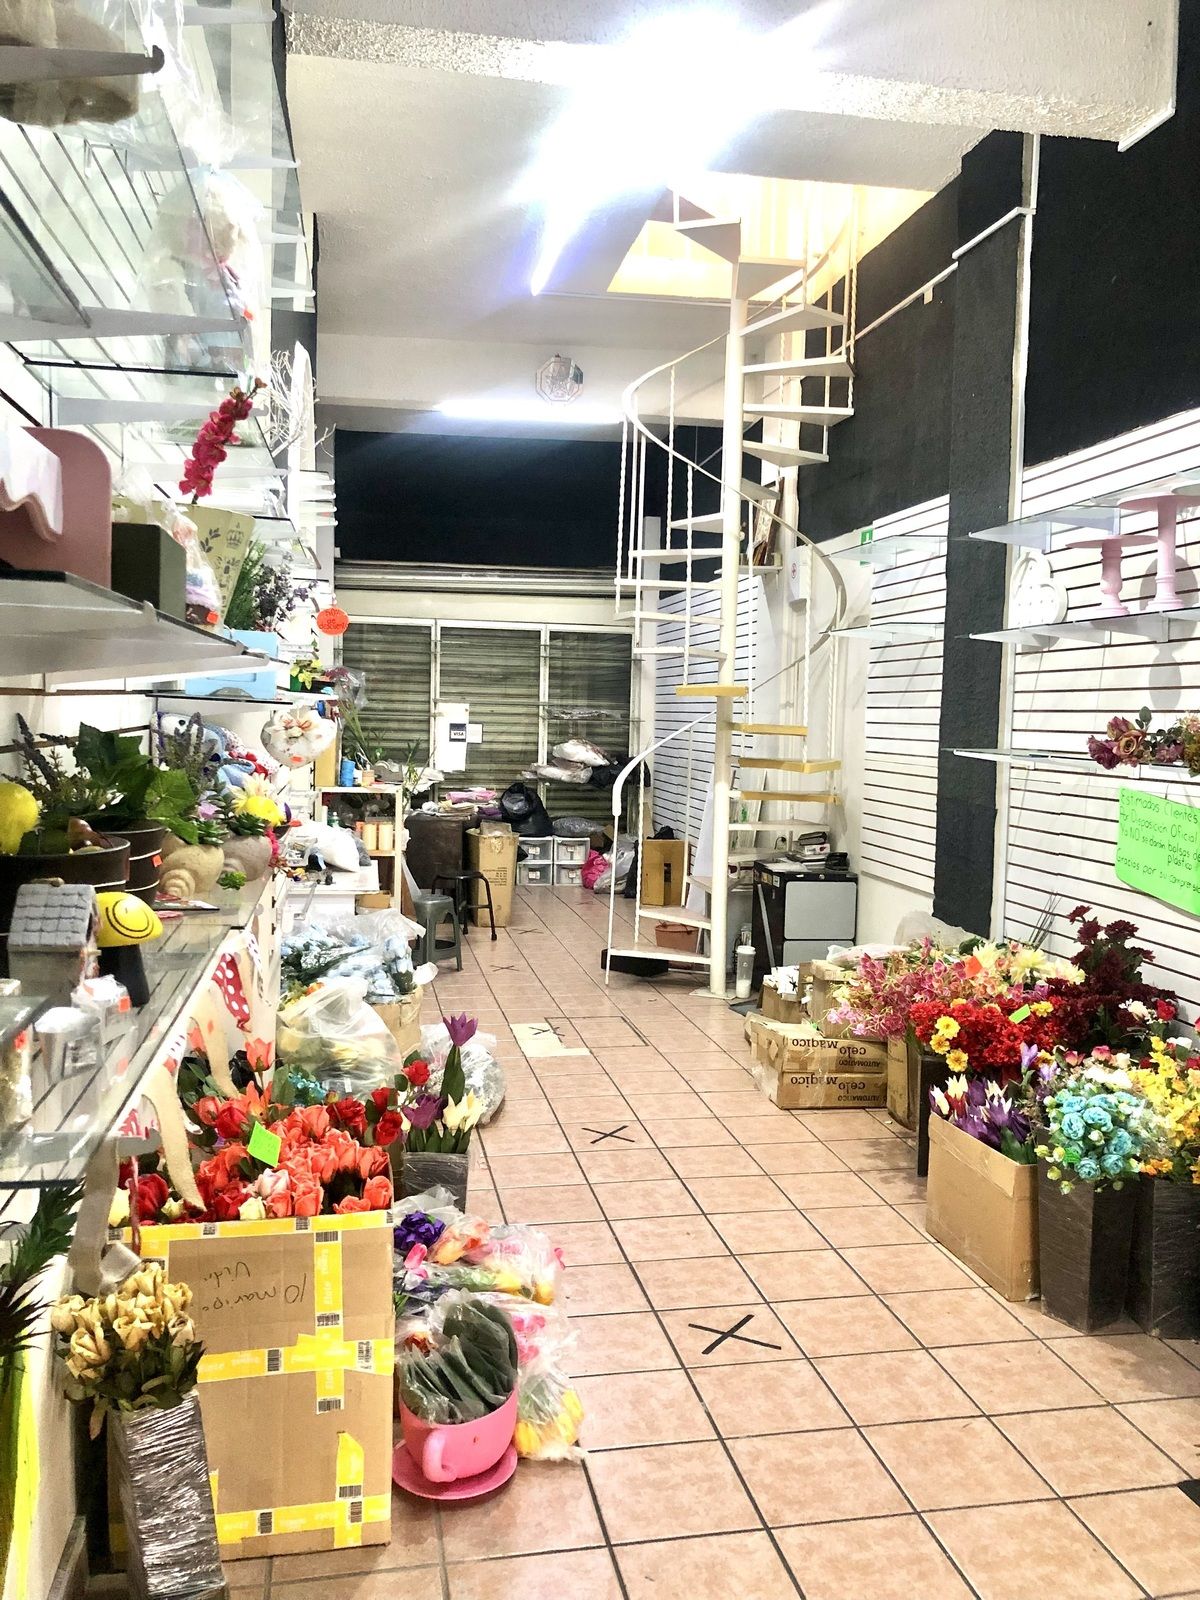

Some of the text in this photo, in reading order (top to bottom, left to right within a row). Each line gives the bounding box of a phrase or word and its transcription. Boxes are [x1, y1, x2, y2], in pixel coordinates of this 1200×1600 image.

[840, 1046, 866, 1058] celo
[838, 1081, 866, 1094] celo
[284, 1273, 307, 1304] 10
